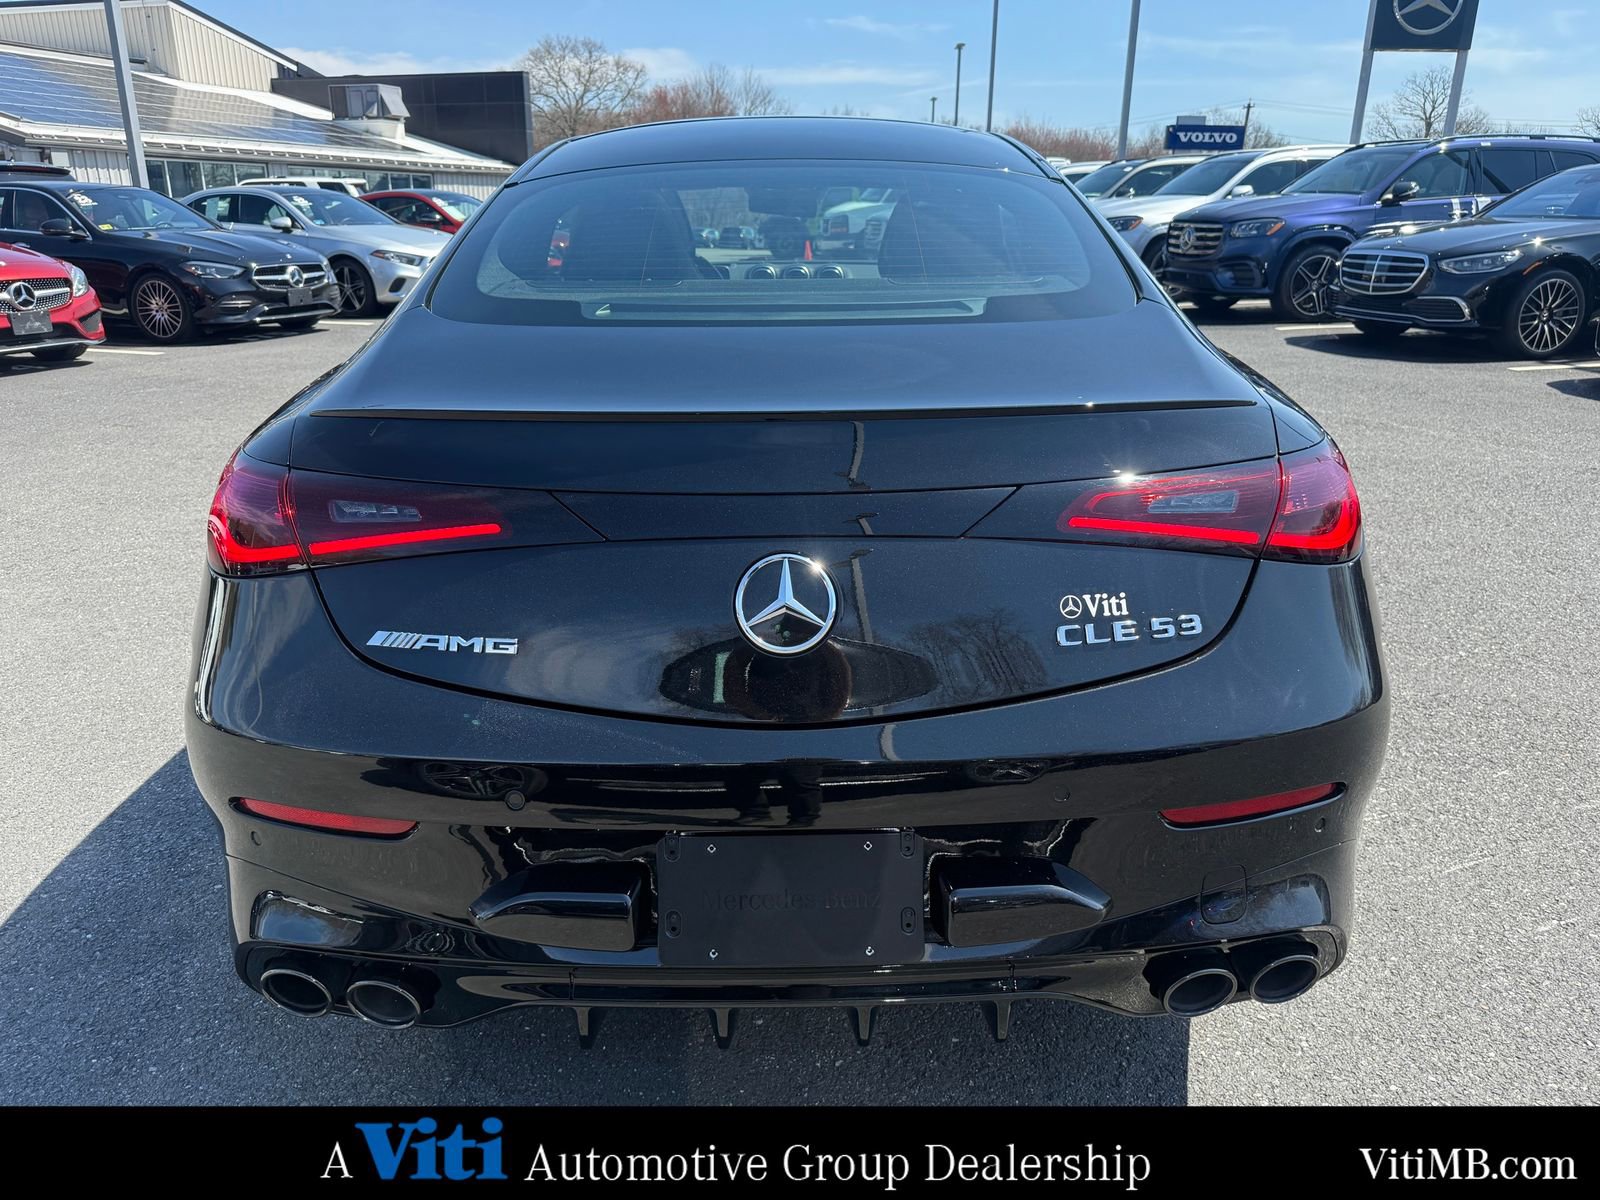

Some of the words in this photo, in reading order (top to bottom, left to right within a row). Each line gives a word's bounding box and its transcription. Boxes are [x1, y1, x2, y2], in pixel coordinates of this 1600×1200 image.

[1177, 131, 1238, 144] VOLVO
[1083, 592, 1129, 618] Viti
[1056, 620, 1140, 647] CLE
[1150, 613, 1203, 639] 53
